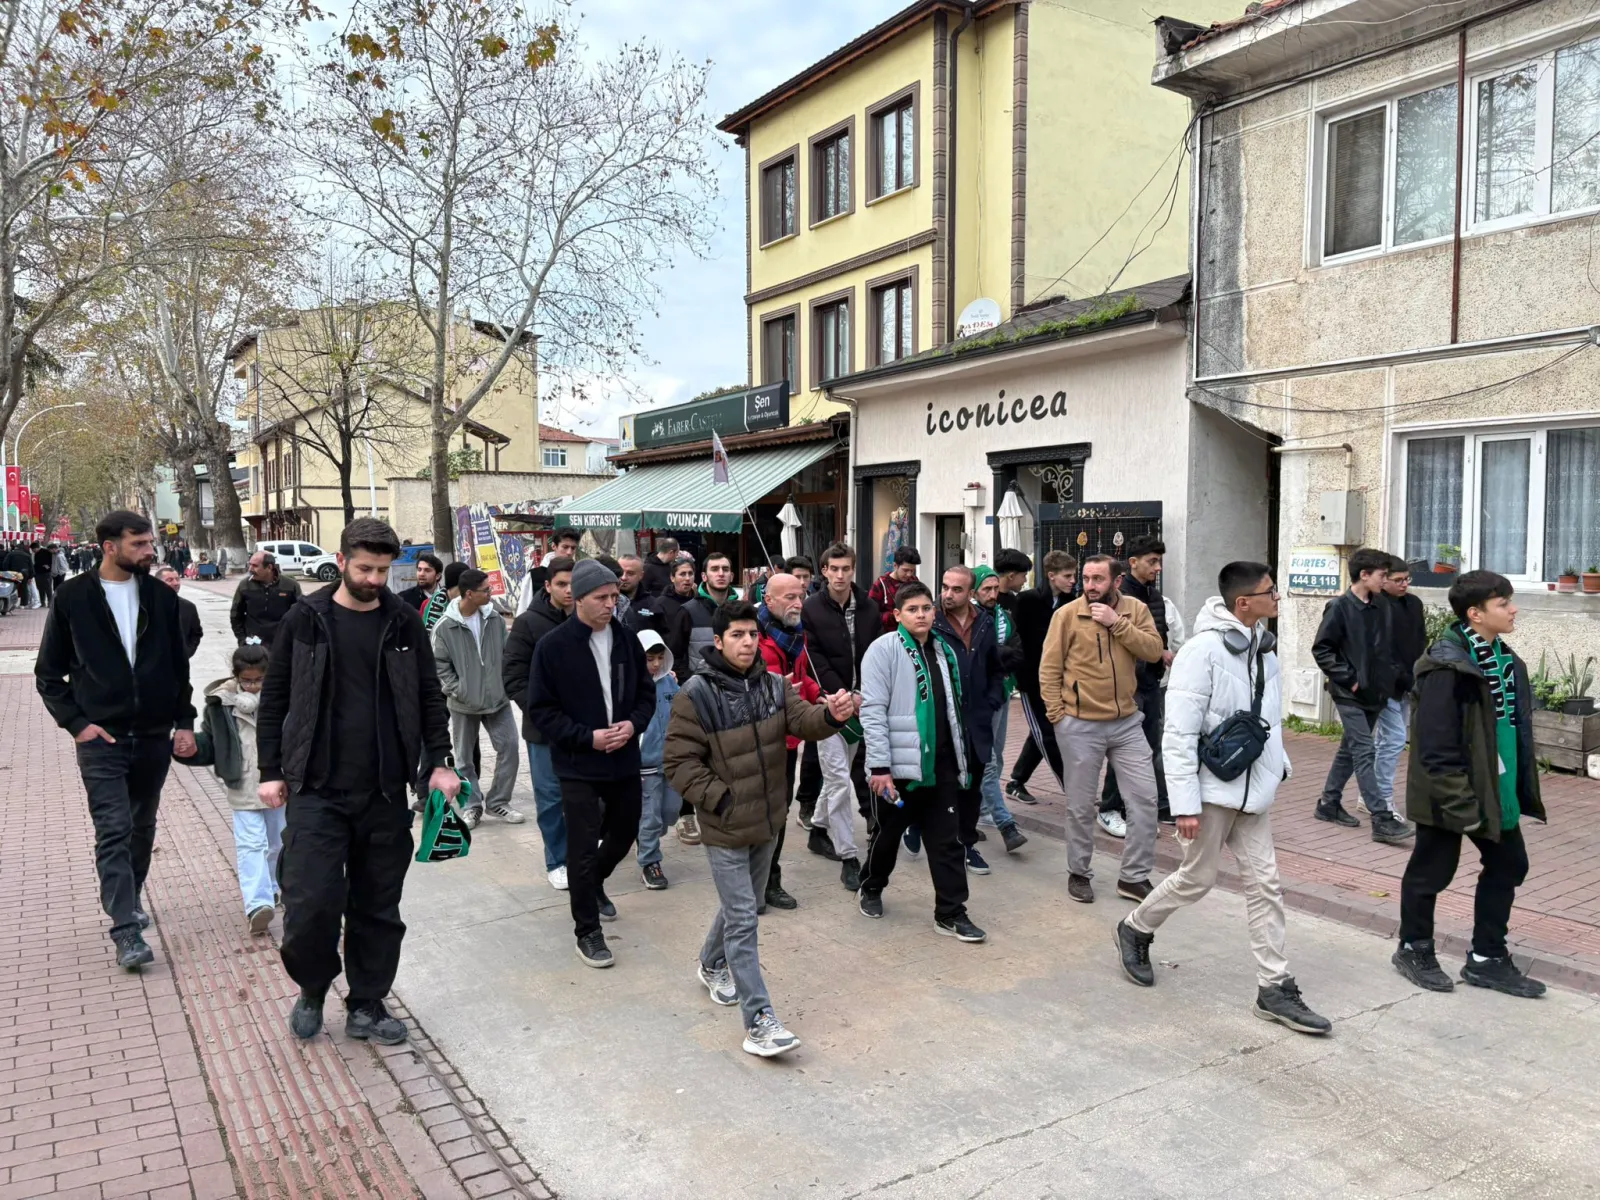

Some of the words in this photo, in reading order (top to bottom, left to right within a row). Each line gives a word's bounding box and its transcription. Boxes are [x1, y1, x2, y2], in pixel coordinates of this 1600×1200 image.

[754, 395, 770, 412] Şen
[926, 389, 1067, 435] iconicea
[666, 513, 712, 528] OYUNCAK
[1291, 558, 1326, 568] FORTES
[1292, 575, 1308, 585] 444
[1311, 575, 1317, 585] 8
[1319, 576, 1337, 586] 118
